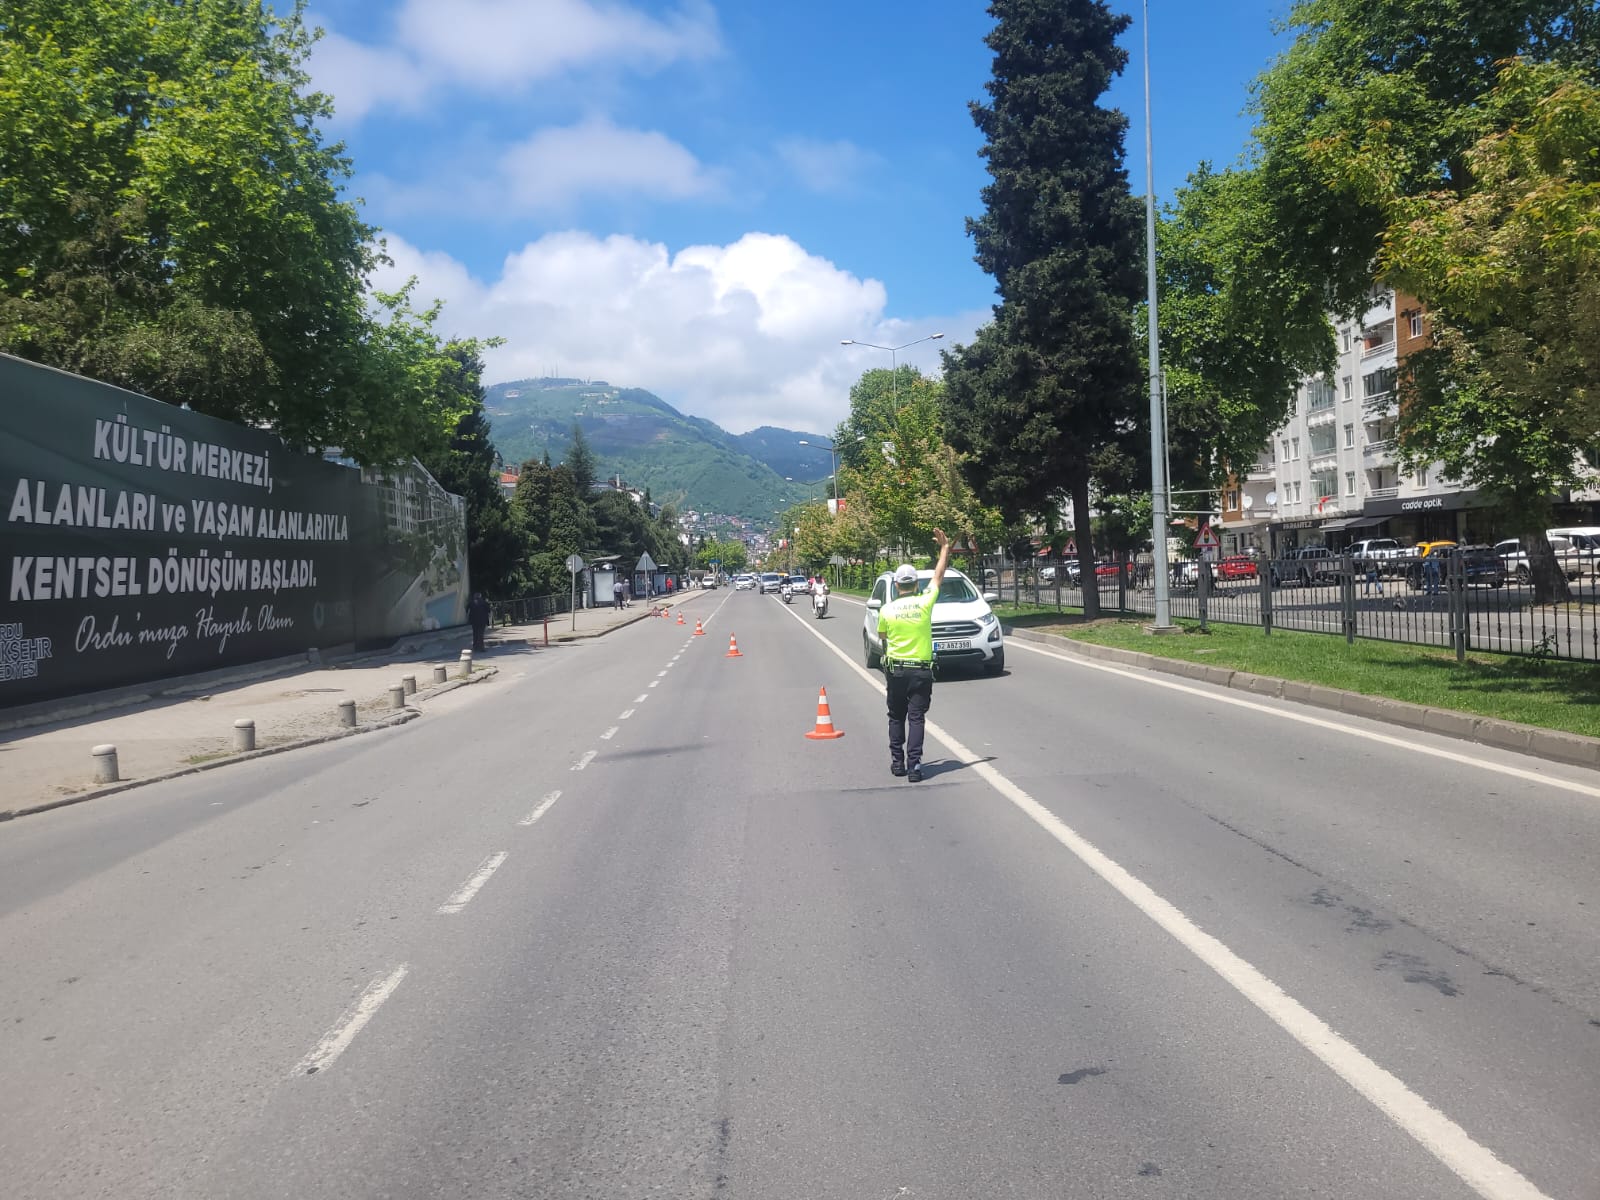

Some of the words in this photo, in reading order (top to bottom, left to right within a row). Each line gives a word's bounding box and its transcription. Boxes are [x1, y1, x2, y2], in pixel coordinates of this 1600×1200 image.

[94, 414, 187, 473] KÜLTÜR
[192, 441, 273, 494] MERKEZİ,
[8, 478, 156, 531] ALANLARI
[162, 503, 187, 533] ve
[192, 500, 254, 541] YAŞAM
[257, 508, 348, 541] ALANLARIYLA
[1401, 500, 1422, 510] cadde
[1423, 498, 1442, 509] optik
[10, 556, 141, 601] KENTSEL
[147, 548, 247, 598] DÖNÜŞÜM
[251, 559, 317, 595] BAŞLADI.
[75, 612, 188, 659] Ordu'muza
[196, 606, 253, 654] Hayırlı
[257, 604, 294, 632] Olsun
